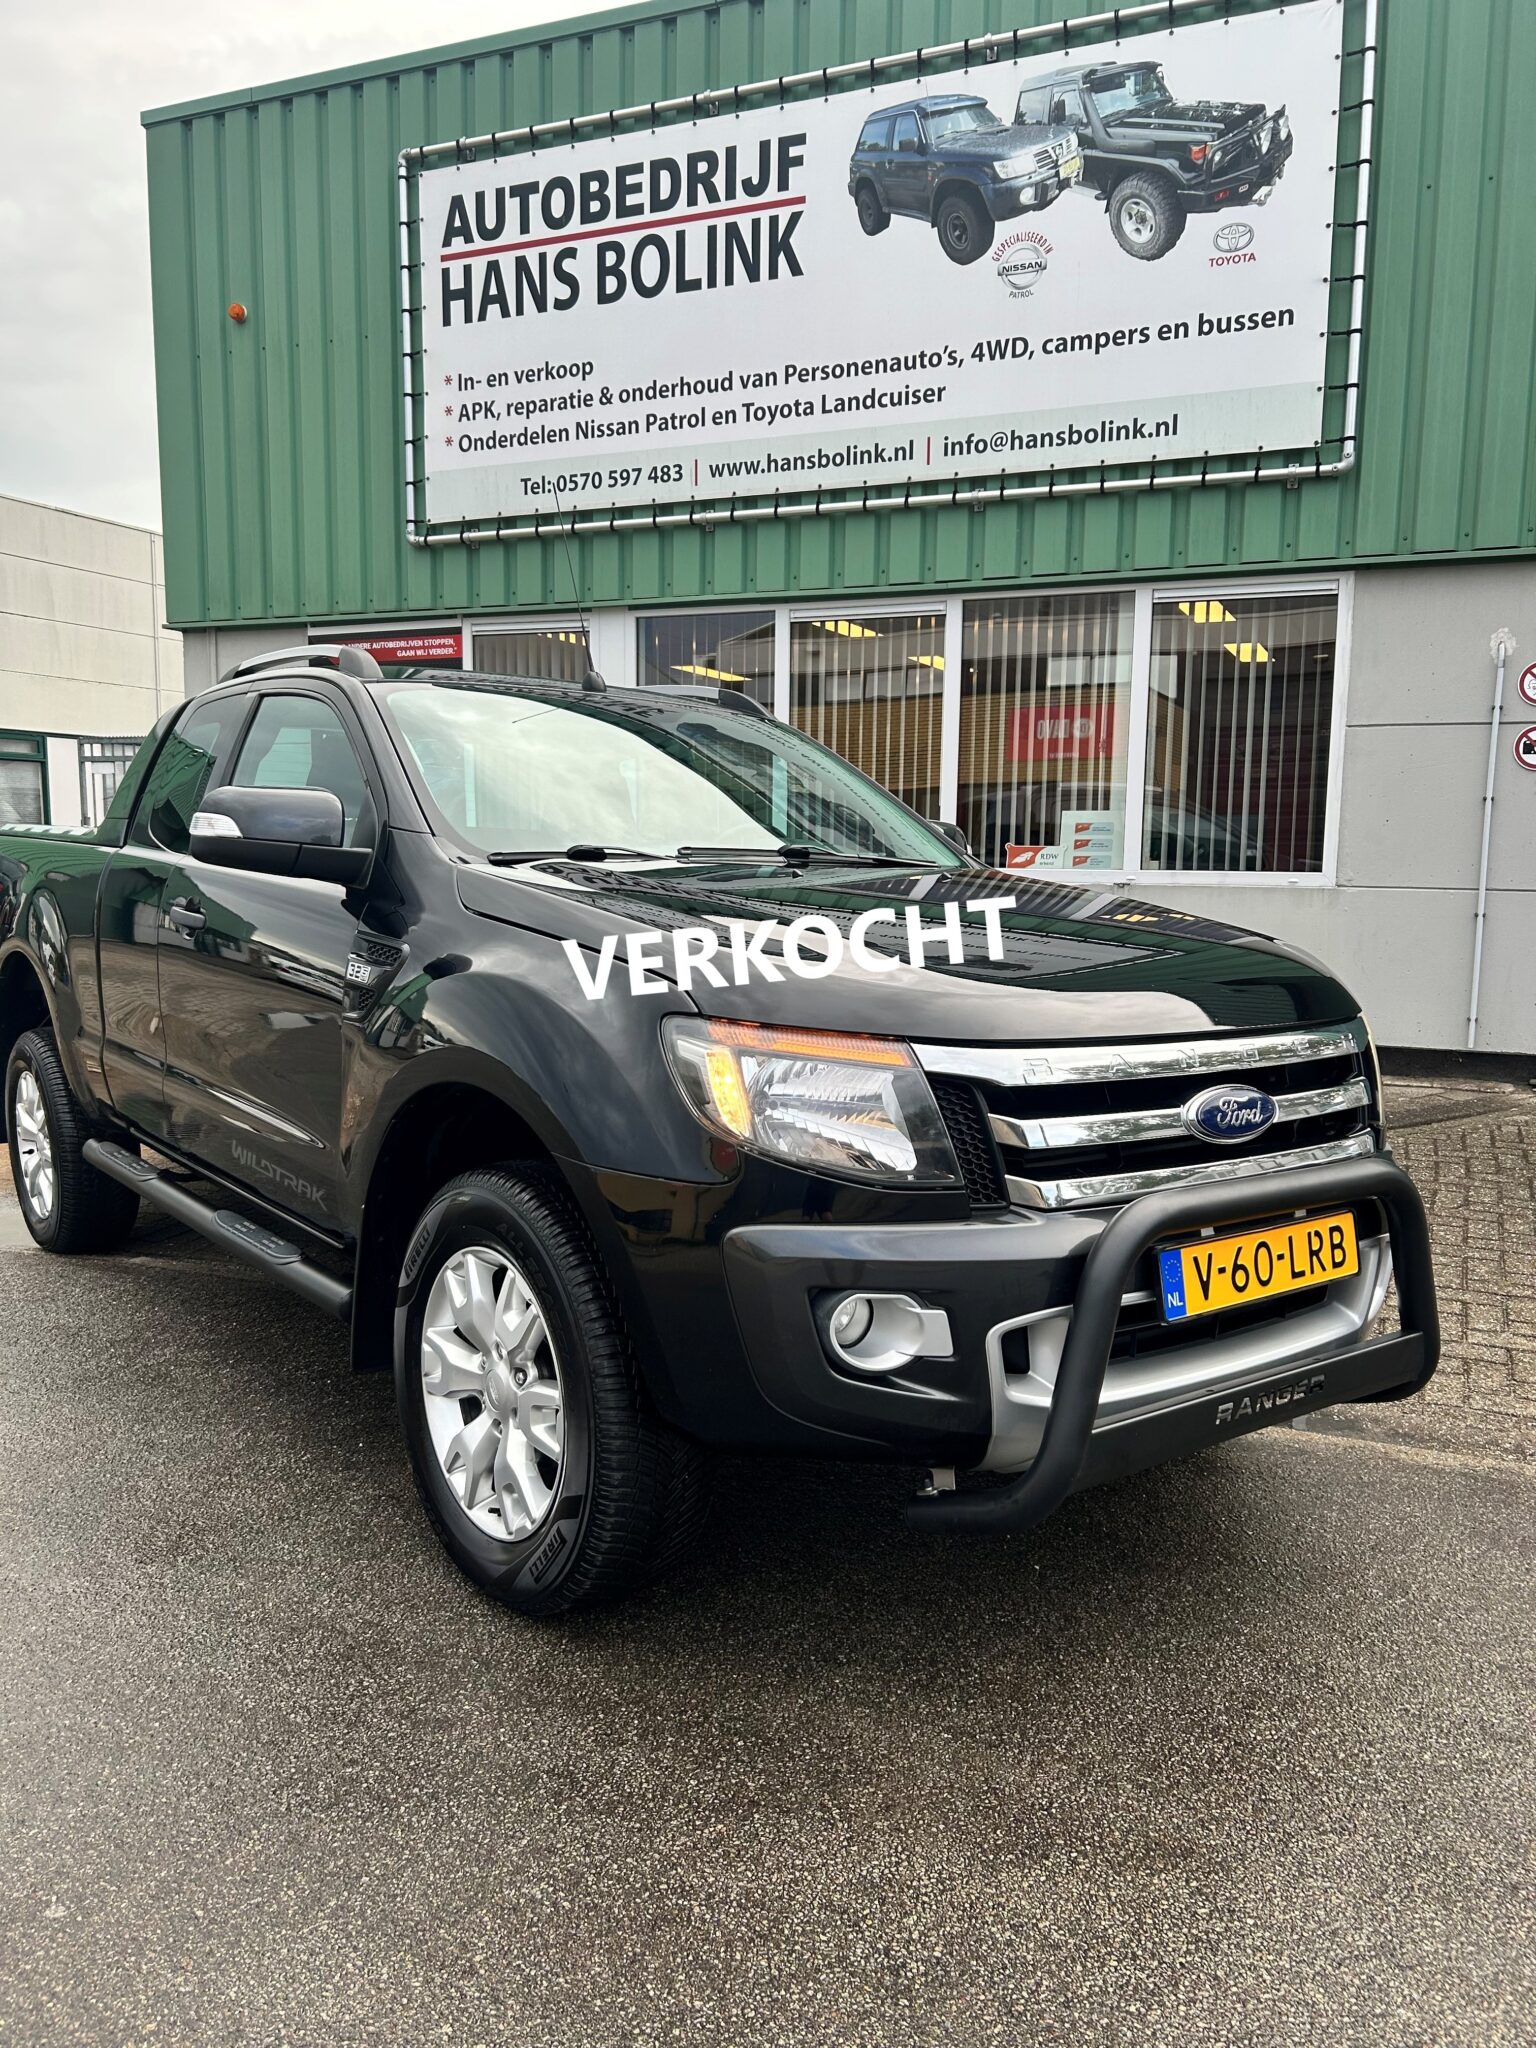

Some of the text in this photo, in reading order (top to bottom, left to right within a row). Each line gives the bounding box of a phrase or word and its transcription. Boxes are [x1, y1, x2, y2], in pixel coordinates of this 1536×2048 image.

[442, 133, 807, 248] AUTOBEDRIJF
[441, 210, 805, 327] HANS BOLINK
[992, 231, 1047, 262] GESPECIALISEERD
[1002, 260, 1043, 274] NISSAN
[1208, 252, 1257, 267] TOYOTA
[1009, 289, 1034, 299] PATROL
[458, 400, 502, 423] APK,
[506, 389, 594, 419] reparatie
[599, 387, 614, 406] &
[618, 370, 734, 404] onderhoud
[739, 372, 778, 391] van
[970, 334, 1035, 364] 4WD,
[1041, 322, 1151, 359] campers
[1157, 319, 1190, 341] en
[1198, 306, 1295, 337] bussen
[458, 360, 595, 392] In- en verkoop
[458, 383, 947, 453] Onderdelen Nissan Patrol en Toyota Landcuiser
[556, 471, 602, 493] 0570
[607, 467, 643, 489] 597
[647, 464, 684, 484] 483
[709, 439, 915, 479] www.hansbolink.nl
[943, 413, 1179, 458] info@hansbolink.nl
[372, 640, 423, 650] AUTOBEDRIJVEN
[424, 638, 456, 647] STOPPEN,
[1217, 1096, 1264, 1130] Ford
[231, 1139, 328, 1212] WILDTRAK
[404, 1222, 432, 1280] PIRELLI
[1192, 1223, 1347, 1302] V-60-LRB
[1166, 1291, 1184, 1310] NL
[1215, 1373, 1326, 1426] RANGER
[529, 1526, 568, 1584] PIRELLI
